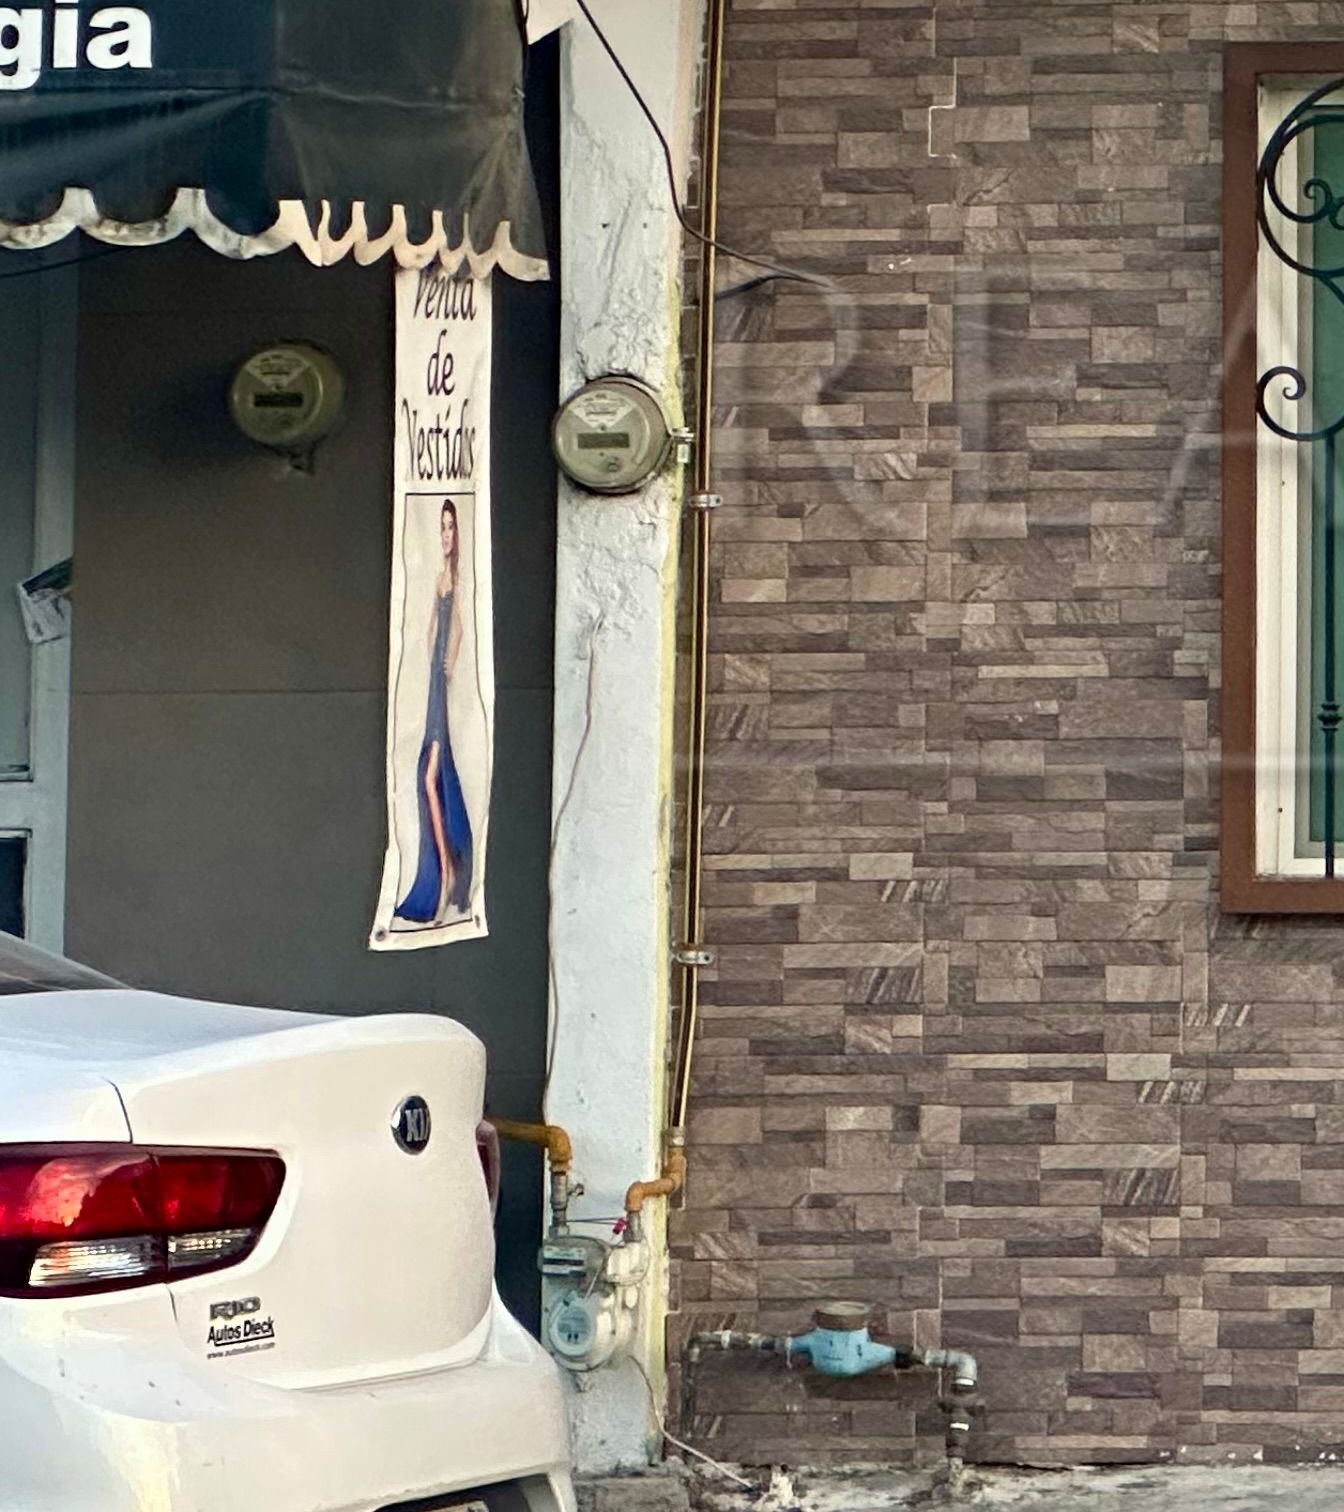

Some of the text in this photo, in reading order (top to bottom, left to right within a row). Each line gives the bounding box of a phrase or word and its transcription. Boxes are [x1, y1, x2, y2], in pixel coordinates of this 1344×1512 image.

[413, 271, 477, 320] Venta
[427, 328, 456, 396] de
[405, 1107, 429, 1142] KI
[207, 1315, 275, 1344] Autos Dieck
